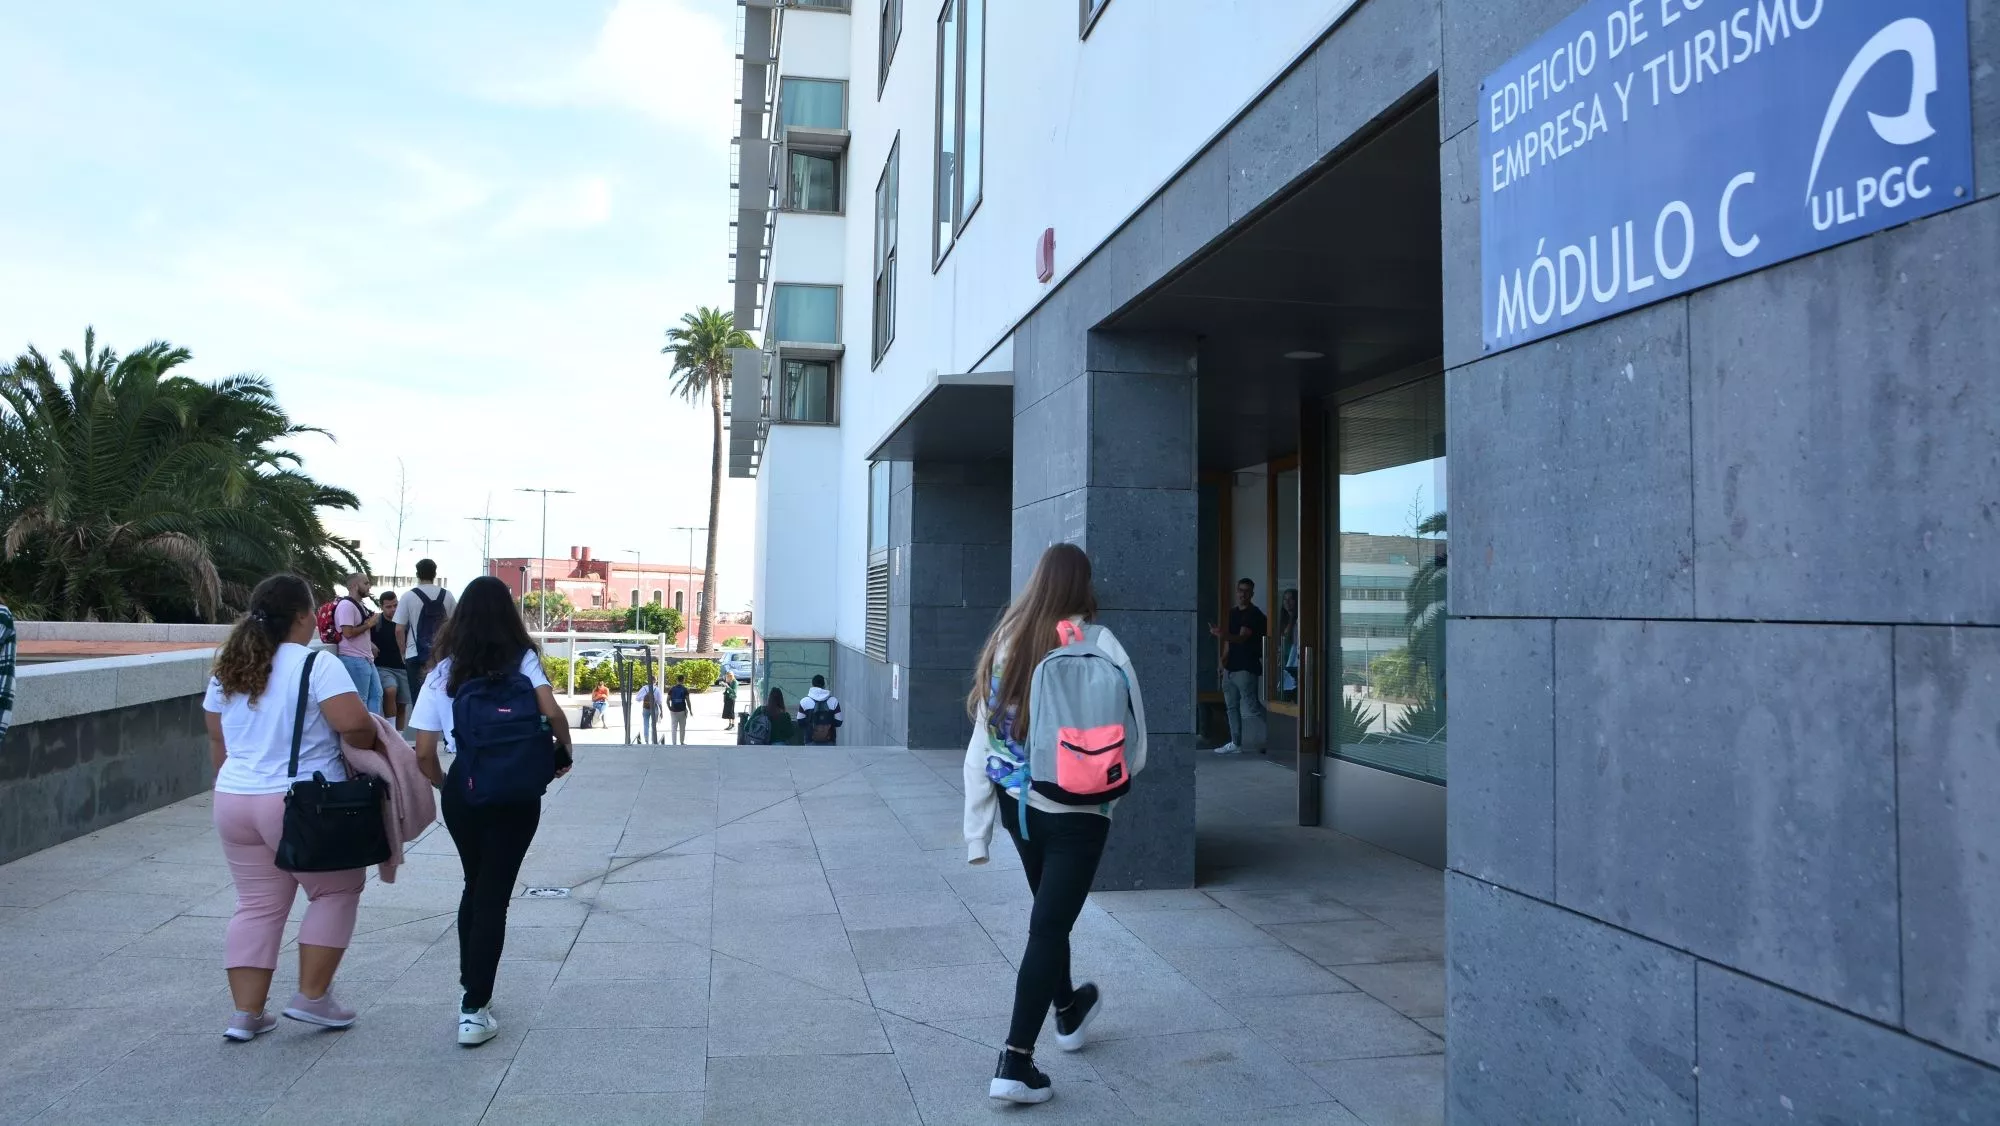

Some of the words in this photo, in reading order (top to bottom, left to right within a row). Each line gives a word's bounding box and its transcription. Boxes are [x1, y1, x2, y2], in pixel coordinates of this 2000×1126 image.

[1491, 30, 1596, 133] EDIFICIO
[1608, 0, 1648, 60] DE
[1661, 0, 1704, 28] E
[1493, 92, 1608, 192] EMPRESA
[1613, 72, 1634, 122] Y
[1643, 0, 1824, 106] TURISMO
[1496, 201, 1694, 338] MÓDULO
[1719, 172, 1760, 257] C
[1811, 157, 1932, 231] ULPGC
